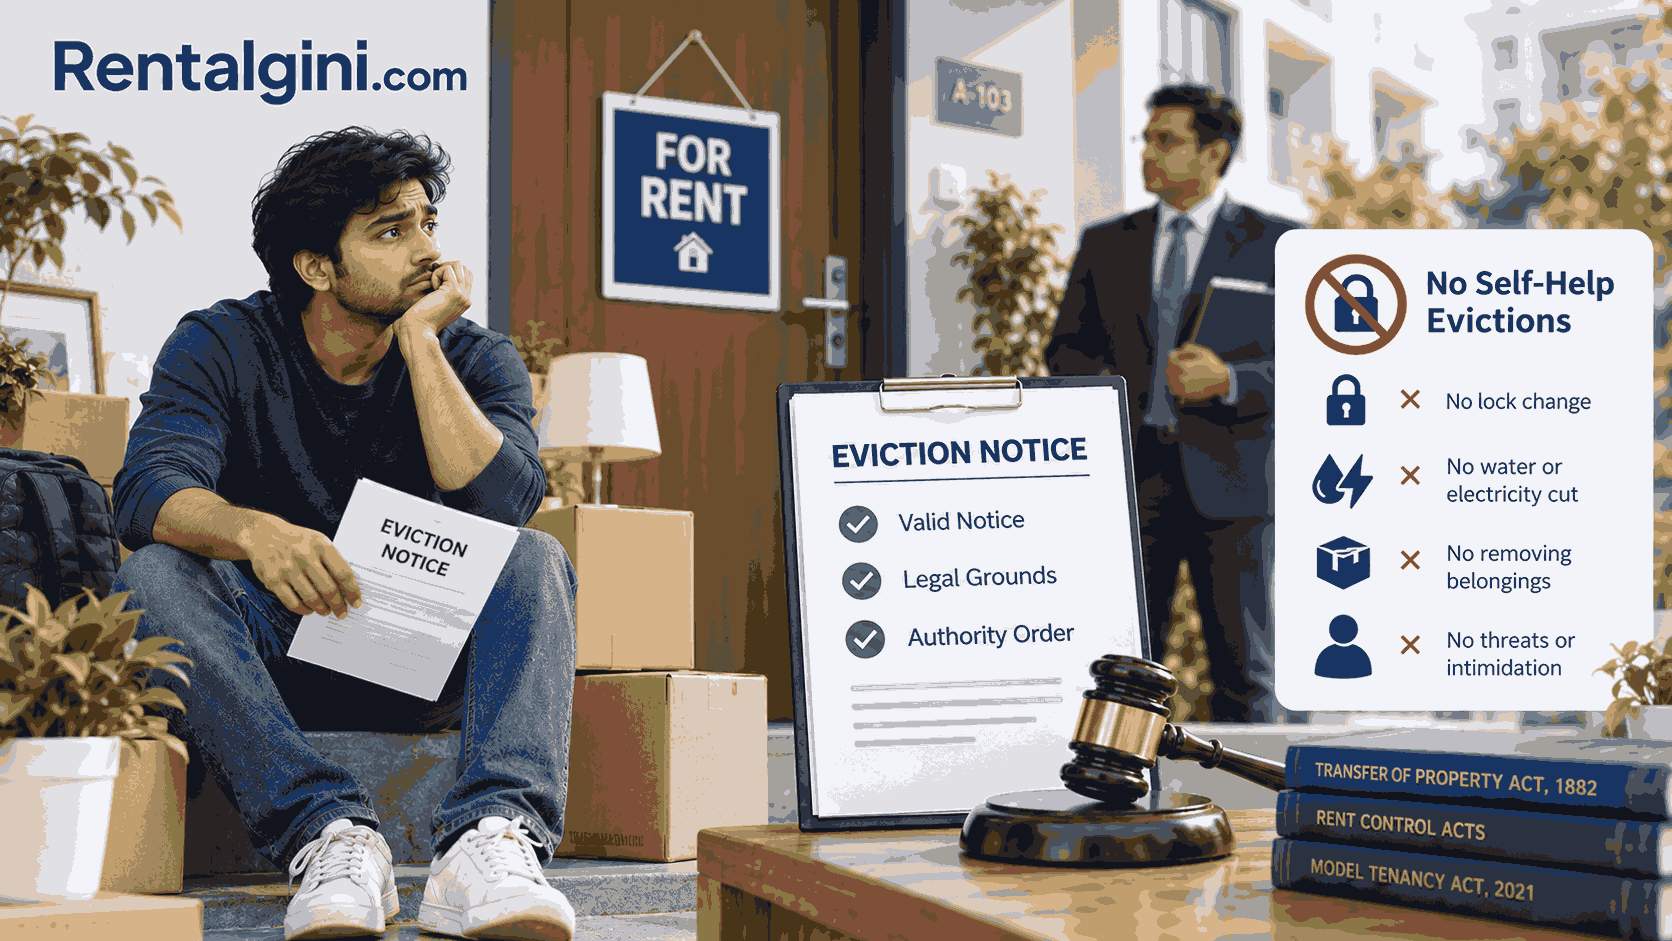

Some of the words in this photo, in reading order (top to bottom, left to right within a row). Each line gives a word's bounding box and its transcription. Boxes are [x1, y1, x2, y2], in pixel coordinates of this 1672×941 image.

[952, 80, 1012, 112] A-103
[656, 131, 732, 177] FOR
[641, 175, 748, 226] RENT
[832, 440, 971, 468] EVICTION
[979, 437, 1088, 464] NOTICE
[898, 509, 950, 532] Valid
[956, 509, 1025, 531] Notice
[380, 518, 468, 558] EVICTION
[381, 543, 450, 577] NOTICE
[903, 567, 960, 593] Legal
[966, 563, 1058, 587] Grounds
[907, 623, 1008, 650] Authority
[1013, 621, 1075, 644] Order
[1315, 762, 1388, 781] TRANSFER
[1391, 767, 1411, 782] OF
[1415, 768, 1503, 789] PROPERTY
[1508, 774, 1549, 796] ACT,
[1555, 777, 1598, 796] 1882
[1316, 809, 1356, 829] RENT
[1360, 813, 1436, 836] CONTROL
[1441, 820, 1486, 841] ACTS
[1310, 858, 1364, 880] MODEL
[1369, 864, 1445, 890] TENANCY
[1450, 875, 1489, 899] ACT,
[1494, 880, 1534, 902] 2021
